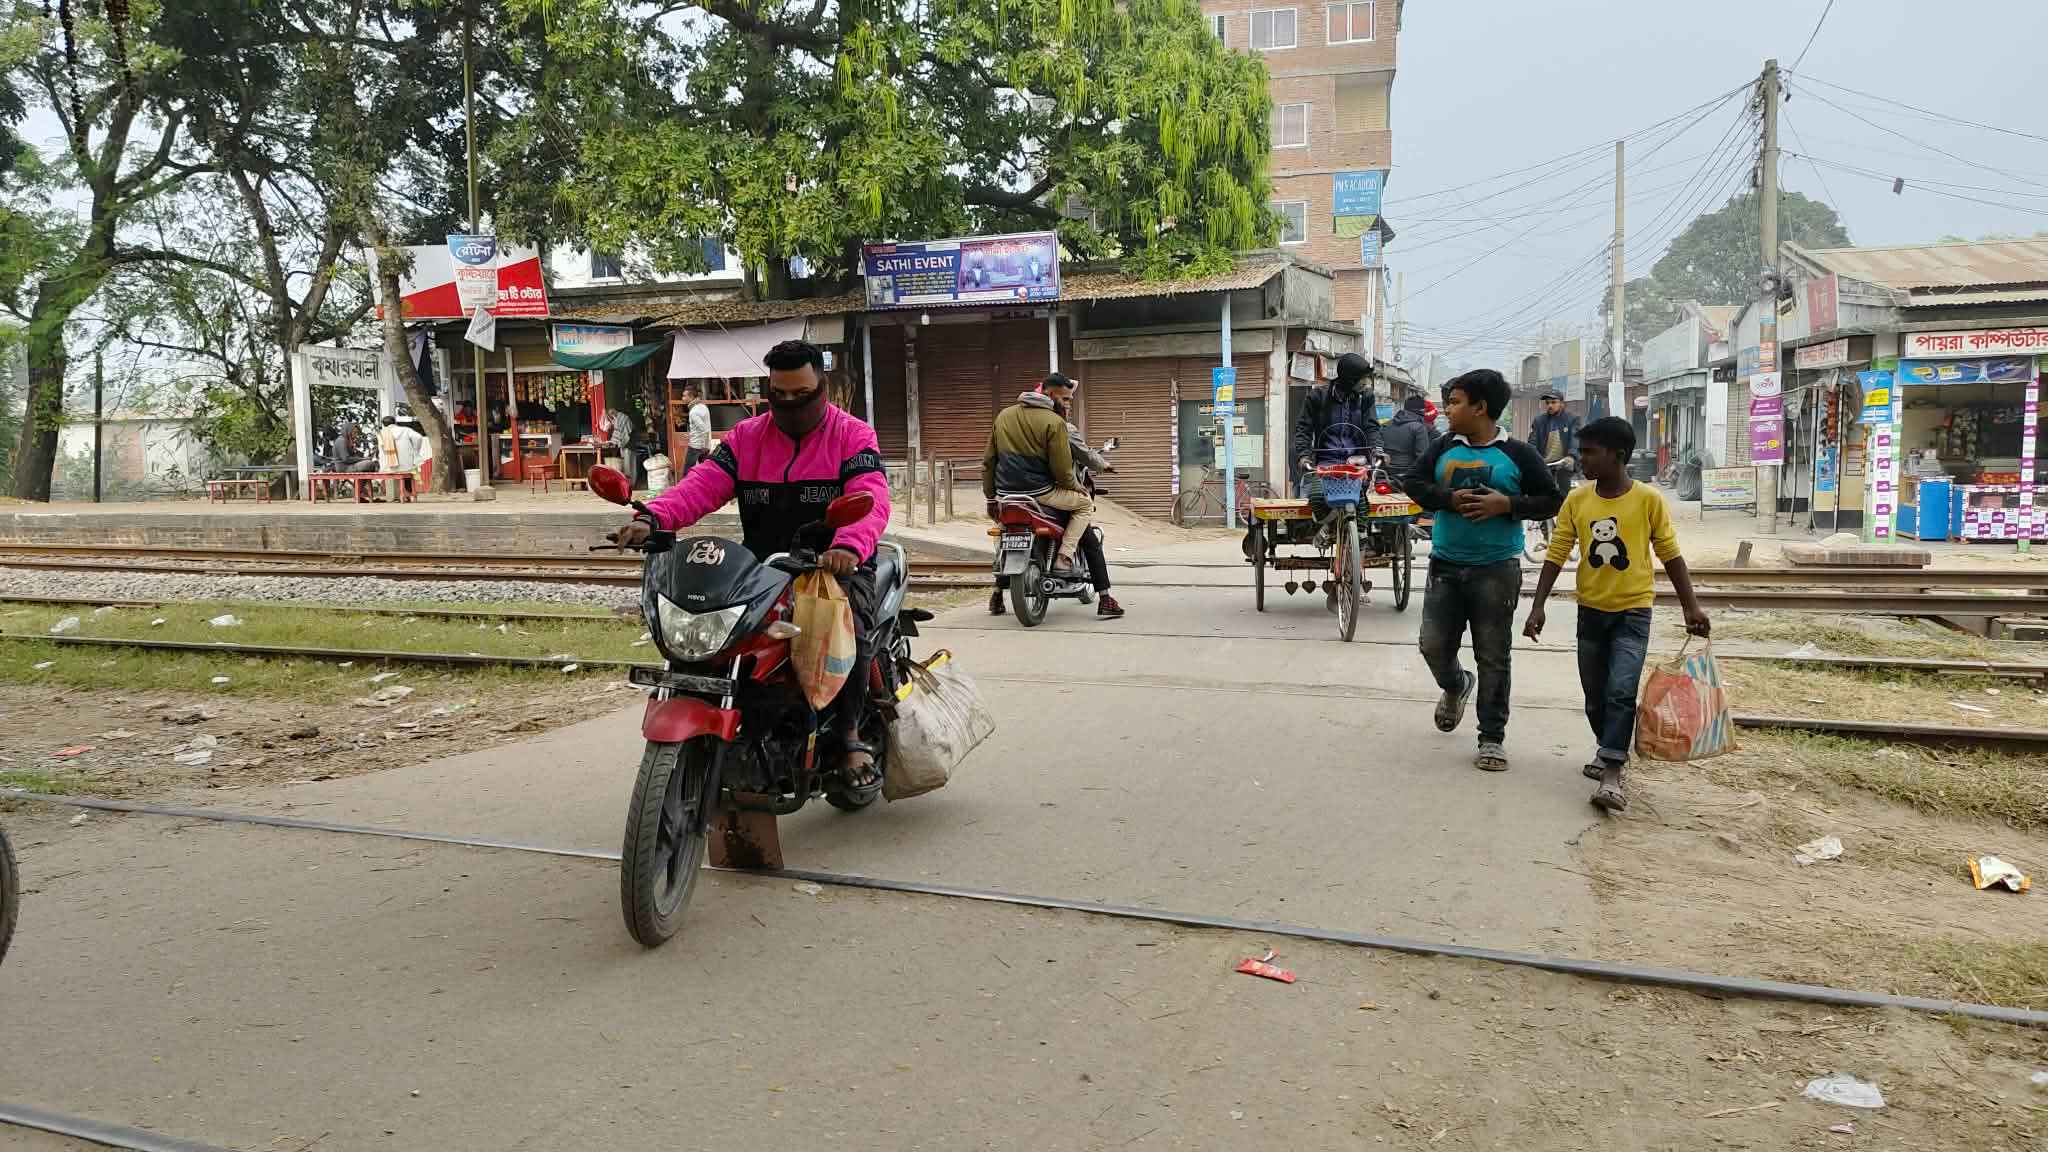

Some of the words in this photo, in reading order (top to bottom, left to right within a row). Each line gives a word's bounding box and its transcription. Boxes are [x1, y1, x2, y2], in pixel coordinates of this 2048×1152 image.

[877, 258, 911, 272] SATHI
[914, 255, 954, 269] EVENT
[1915, 335, 1964, 352] পায়রা
[1968, 328, 2048, 350] কম্পিউটার
